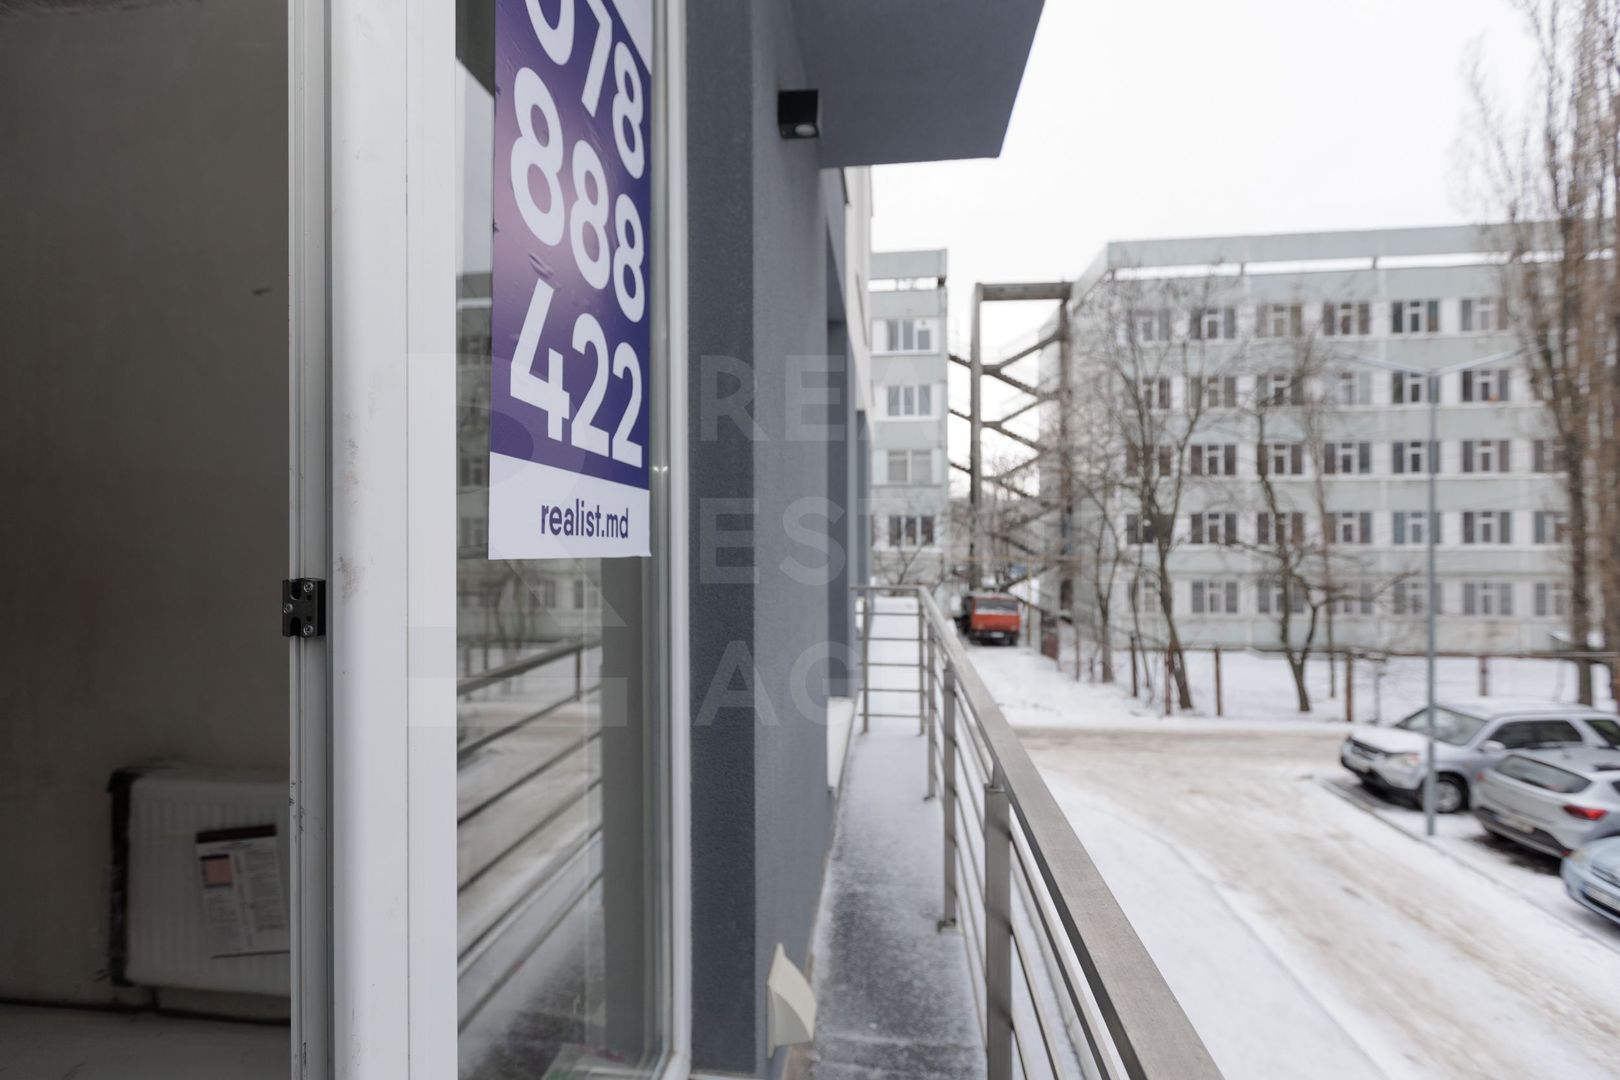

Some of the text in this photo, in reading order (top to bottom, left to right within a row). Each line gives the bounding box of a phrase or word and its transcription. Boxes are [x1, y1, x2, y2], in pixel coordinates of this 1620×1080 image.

[510, 66, 646, 323] 888
[510, 277, 643, 469] 422
[540, 498, 630, 539] realist.md
